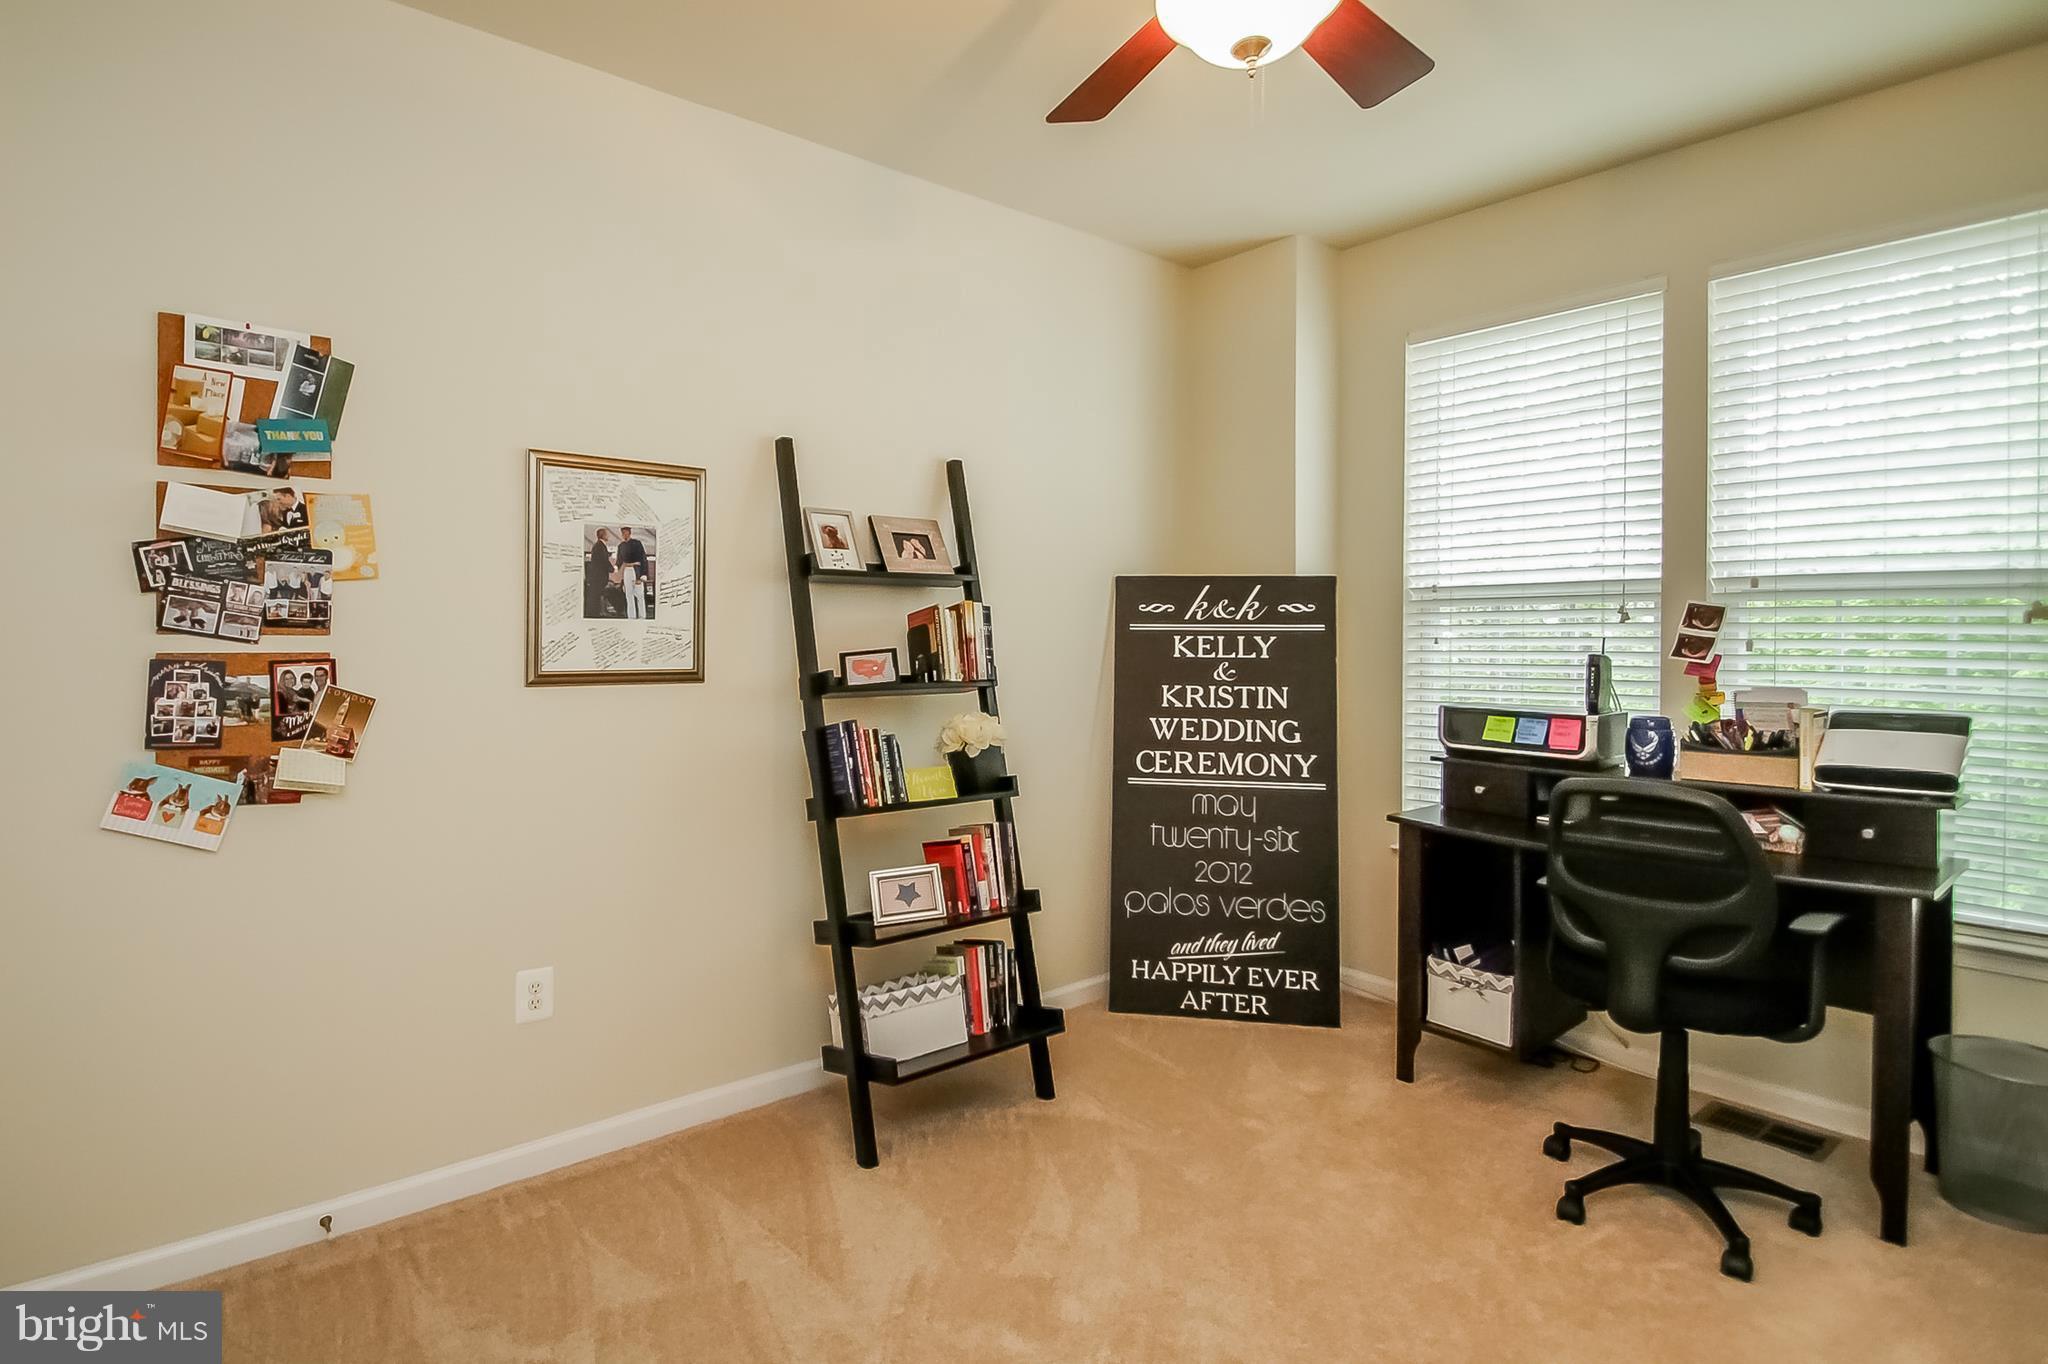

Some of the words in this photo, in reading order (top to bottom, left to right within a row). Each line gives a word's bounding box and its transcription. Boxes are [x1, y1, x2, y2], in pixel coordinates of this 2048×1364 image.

[264, 430, 300, 441] THANK
[302, 430, 324, 441] YOU
[172, 577, 222, 594] BLESSINGS
[1173, 635, 1278, 659] KELLY
[1213, 661, 1238, 682] &
[327, 687, 374, 706] LONDON
[1161, 684, 1289, 710] KRISTIN
[1149, 717, 1302, 744] WEDDING
[1135, 749, 1318, 778] CEREMONY
[1192, 793, 1257, 823] may
[1150, 823, 1301, 857] twenty-six
[1194, 860, 1253, 885] 2012
[1124, 887, 1210, 919] palos
[1219, 892, 1327, 924] verdes
[1170, 936, 1205, 955] and
[1204, 932, 1238, 960] they
[1241, 931, 1282, 954] lived
[1131, 959, 1241, 985] HAPPILY
[1248, 967, 1321, 992] EVER
[1180, 990, 1270, 1016] AFTER
